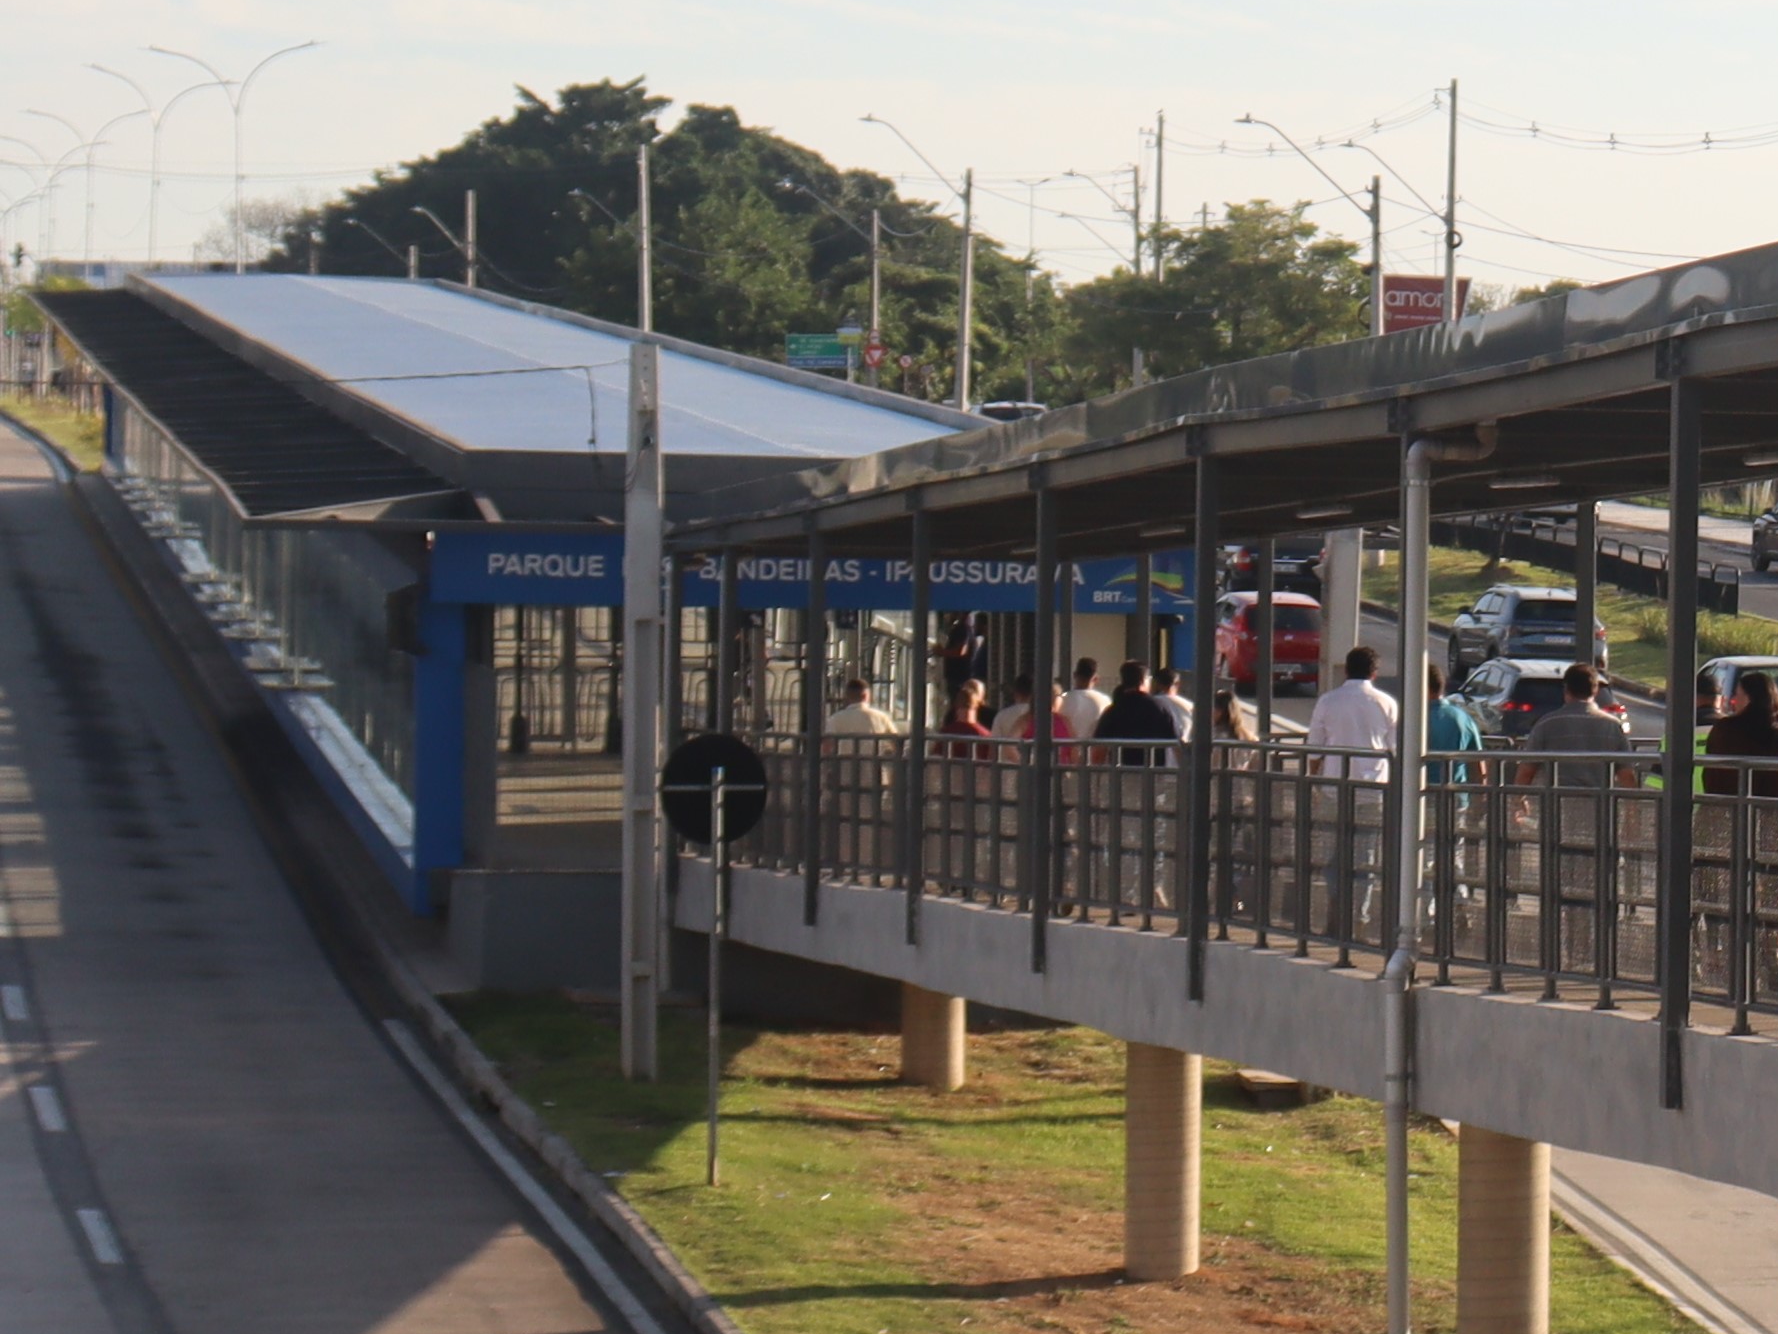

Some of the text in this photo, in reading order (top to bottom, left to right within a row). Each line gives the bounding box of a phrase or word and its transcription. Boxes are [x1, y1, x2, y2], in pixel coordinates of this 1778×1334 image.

[487, 553, 605, 578] PARQUE
[700, 557, 860, 581] BNDEIAS
[885, 560, 1085, 585] IPUSSURAA
[1093, 590, 1122, 603] BRT
